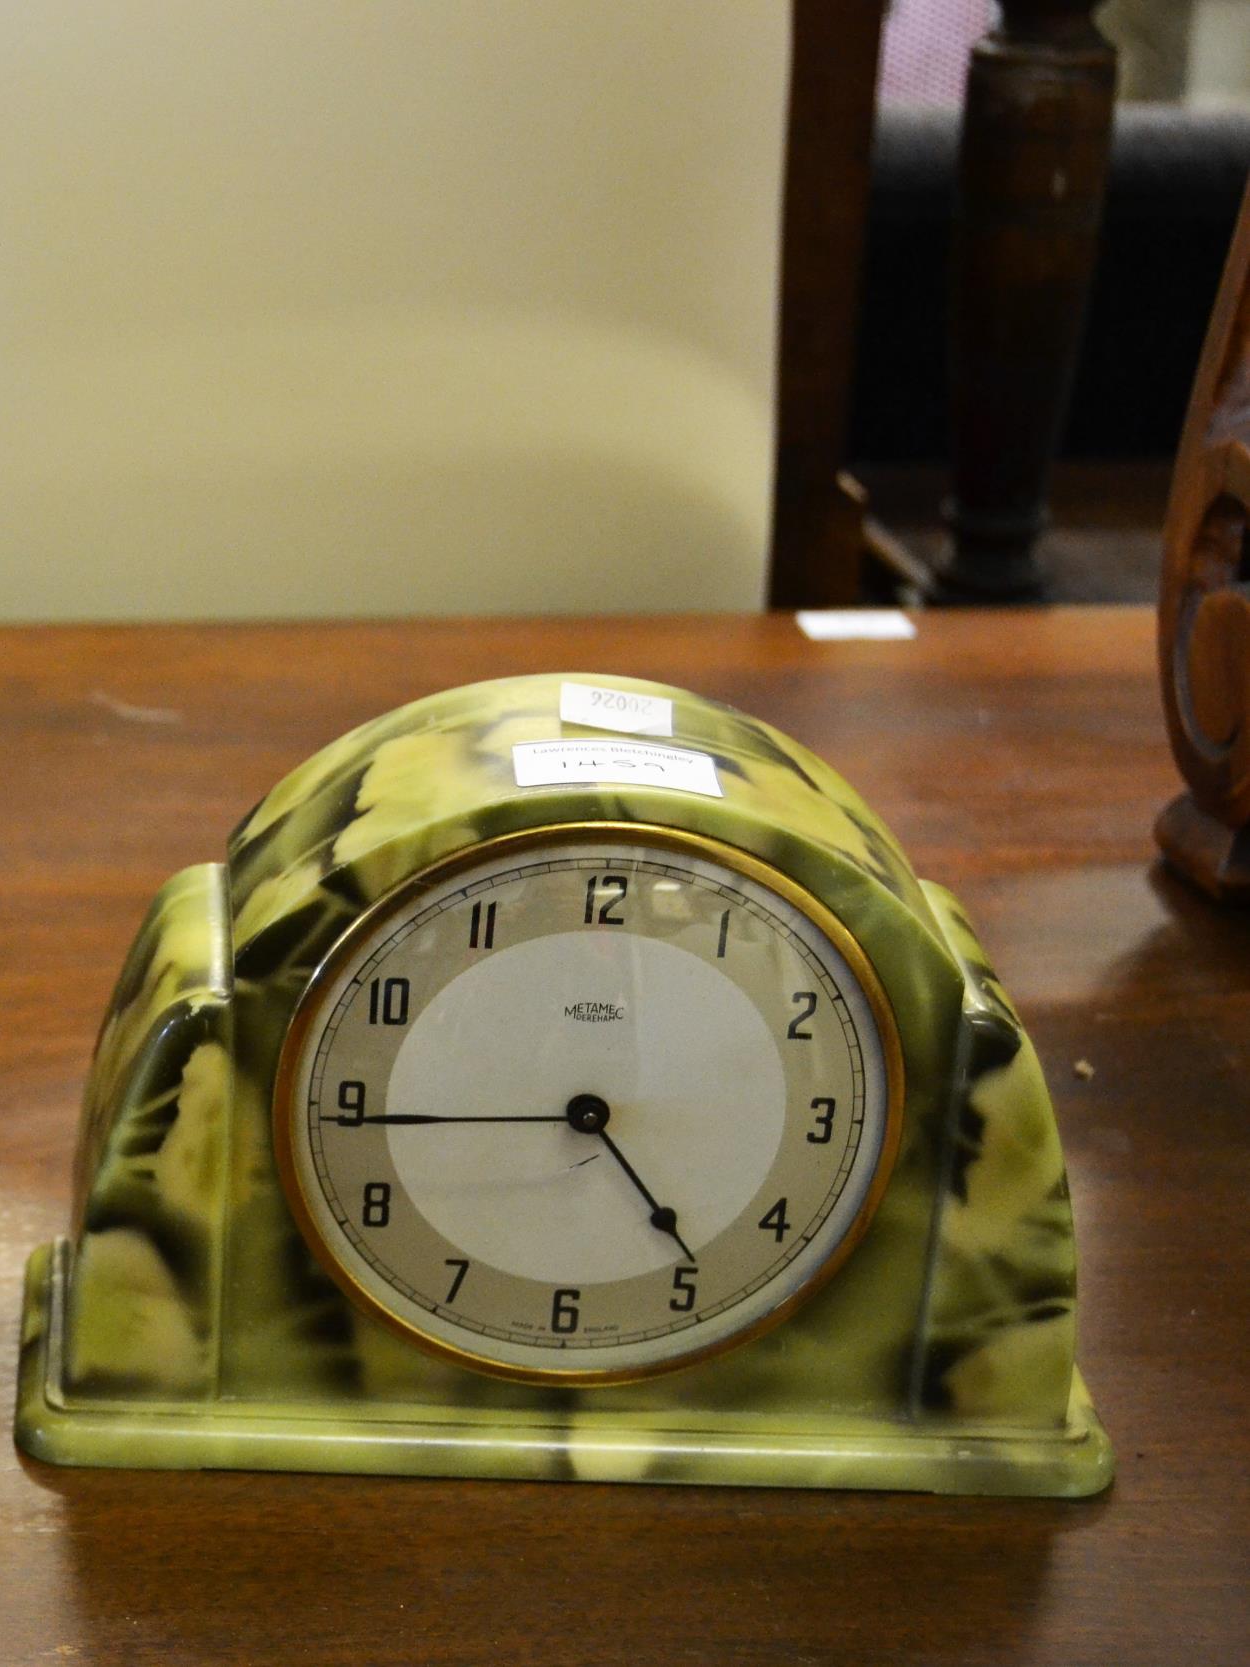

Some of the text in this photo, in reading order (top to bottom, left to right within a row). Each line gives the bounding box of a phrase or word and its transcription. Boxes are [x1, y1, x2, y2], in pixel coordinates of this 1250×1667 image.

[583, 875, 628, 925] 12
[469, 901, 497, 949] 11
[716, 909, 730, 958] 1
[369, 977, 410, 1026] 10
[564, 1003, 624, 1020] METAMEC
[576, 1013, 616, 1023] DEREHAM
[787, 991, 818, 1040] 2
[338, 1081, 365, 1127] 9
[806, 1097, 836, 1144] 3
[362, 1183, 391, 1228] 8
[759, 1198, 791, 1243] 4
[445, 1259, 469, 1303] 7
[670, 1267, 699, 1311] 5
[552, 1289, 581, 1334] 6
